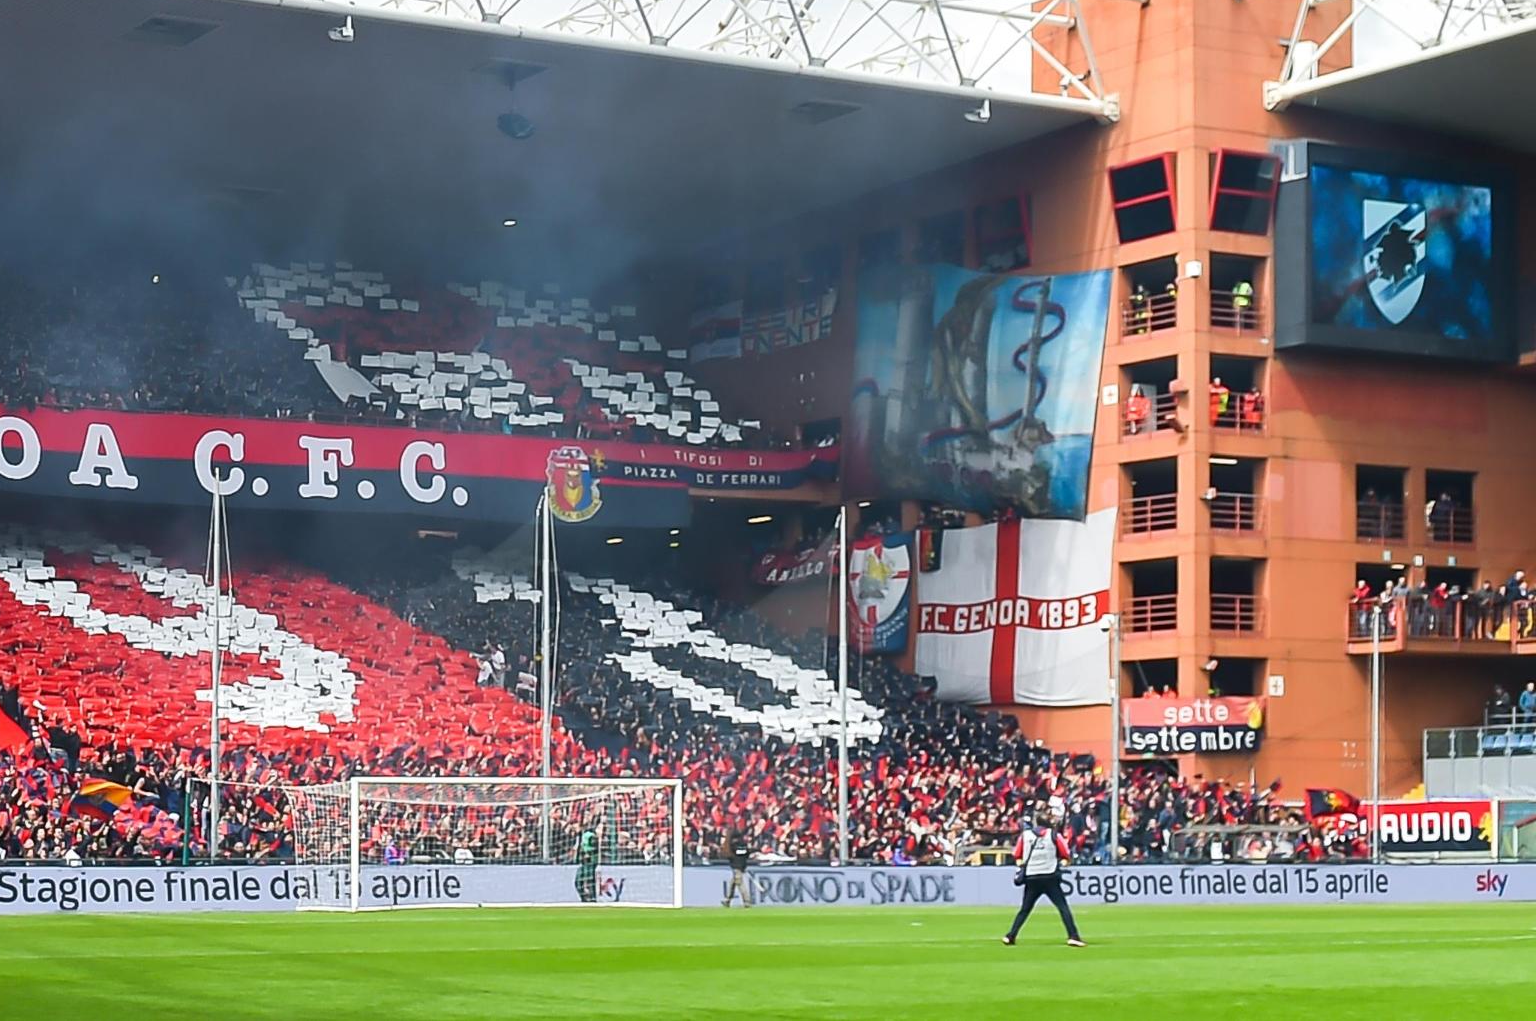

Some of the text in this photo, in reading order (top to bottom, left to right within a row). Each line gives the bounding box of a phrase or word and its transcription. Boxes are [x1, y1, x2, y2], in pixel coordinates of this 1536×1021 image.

[674, 449, 723, 466] TIFOSI
[749, 455, 763, 466] DI
[624, 466, 781, 485] PIAZZA DE FERRARI
[954, 599, 1030, 632] GENOA
[1037, 594, 1097, 628] 1893
[1164, 699, 1229, 725] sette
[164, 870, 261, 901] finale
[270, 869, 319, 900] dal
[372, 868, 461, 905] aprile
[597, 872, 626, 902] ky
[870, 869, 954, 905] SPADE
[1061, 867, 1388, 903] Stagione finale dal 15 aprile
[1476, 870, 1509, 897] sky
